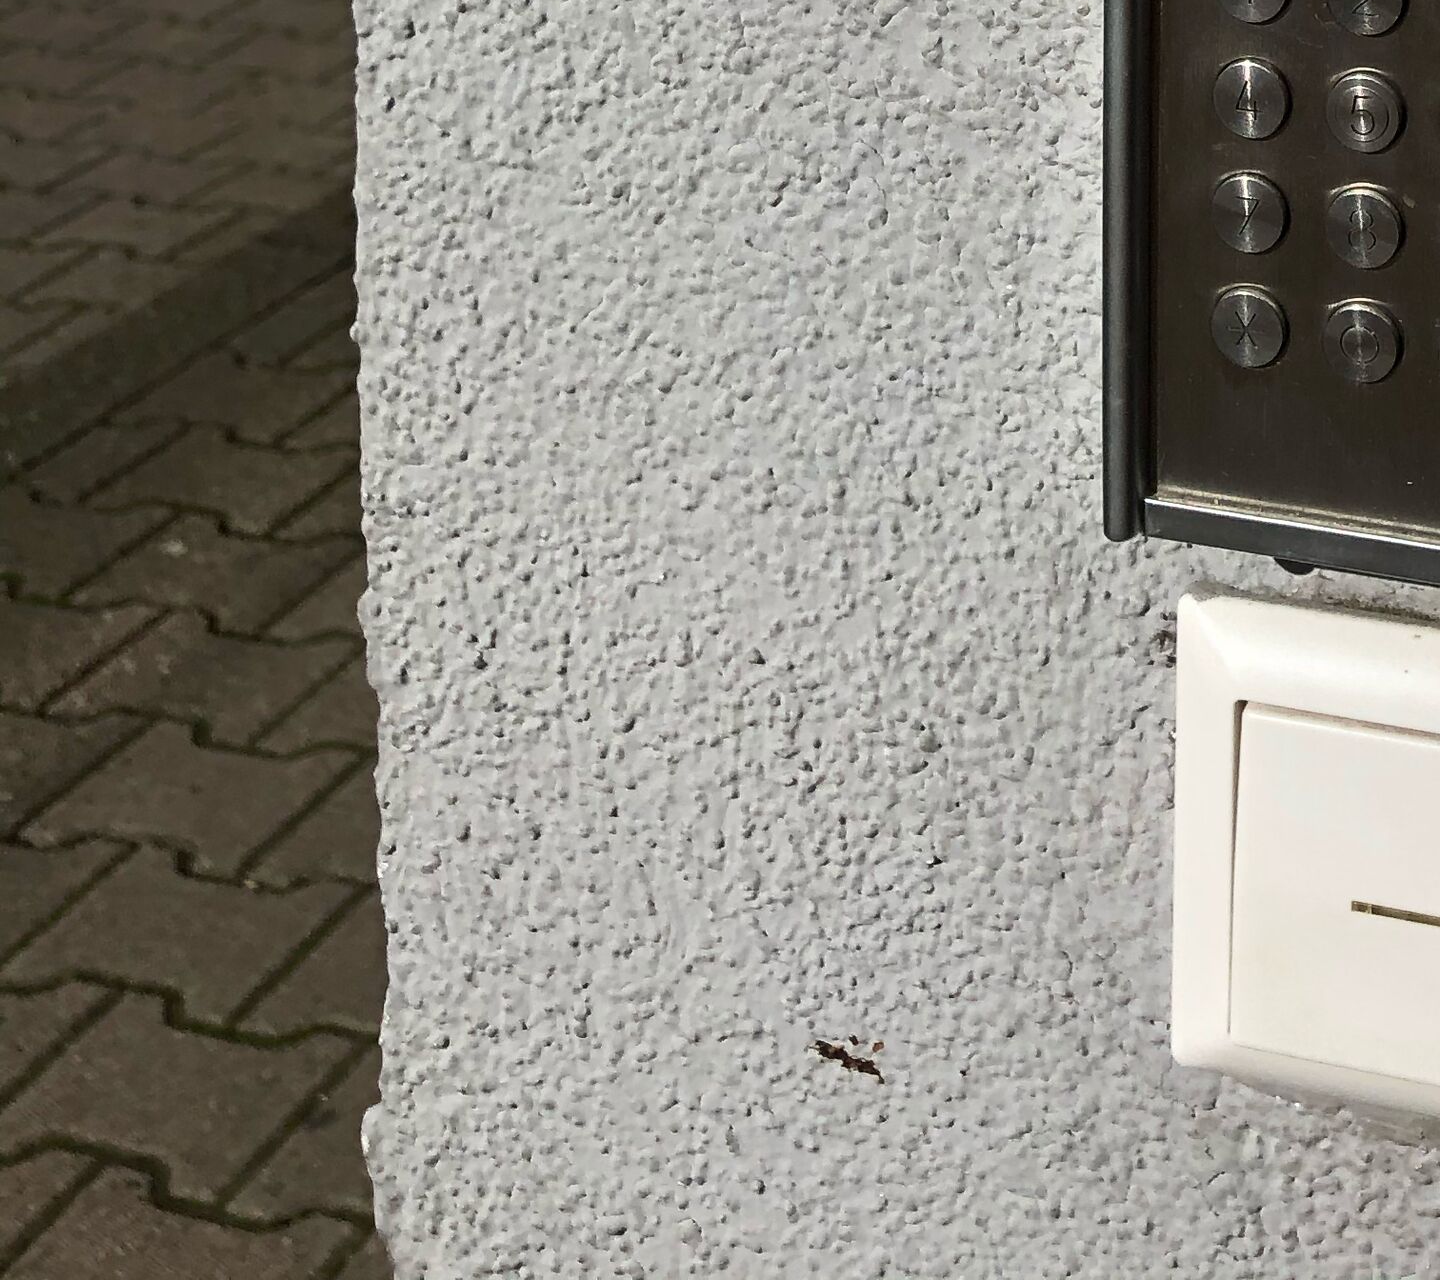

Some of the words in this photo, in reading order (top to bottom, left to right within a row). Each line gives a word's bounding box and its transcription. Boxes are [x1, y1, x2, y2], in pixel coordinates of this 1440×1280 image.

[1236, 81, 1263, 121] 4
[1350, 95, 1375, 135] 5
[1236, 196, 1260, 235] 7
[1349, 210, 1376, 251] 8
[1340, 326, 1379, 364] 0
